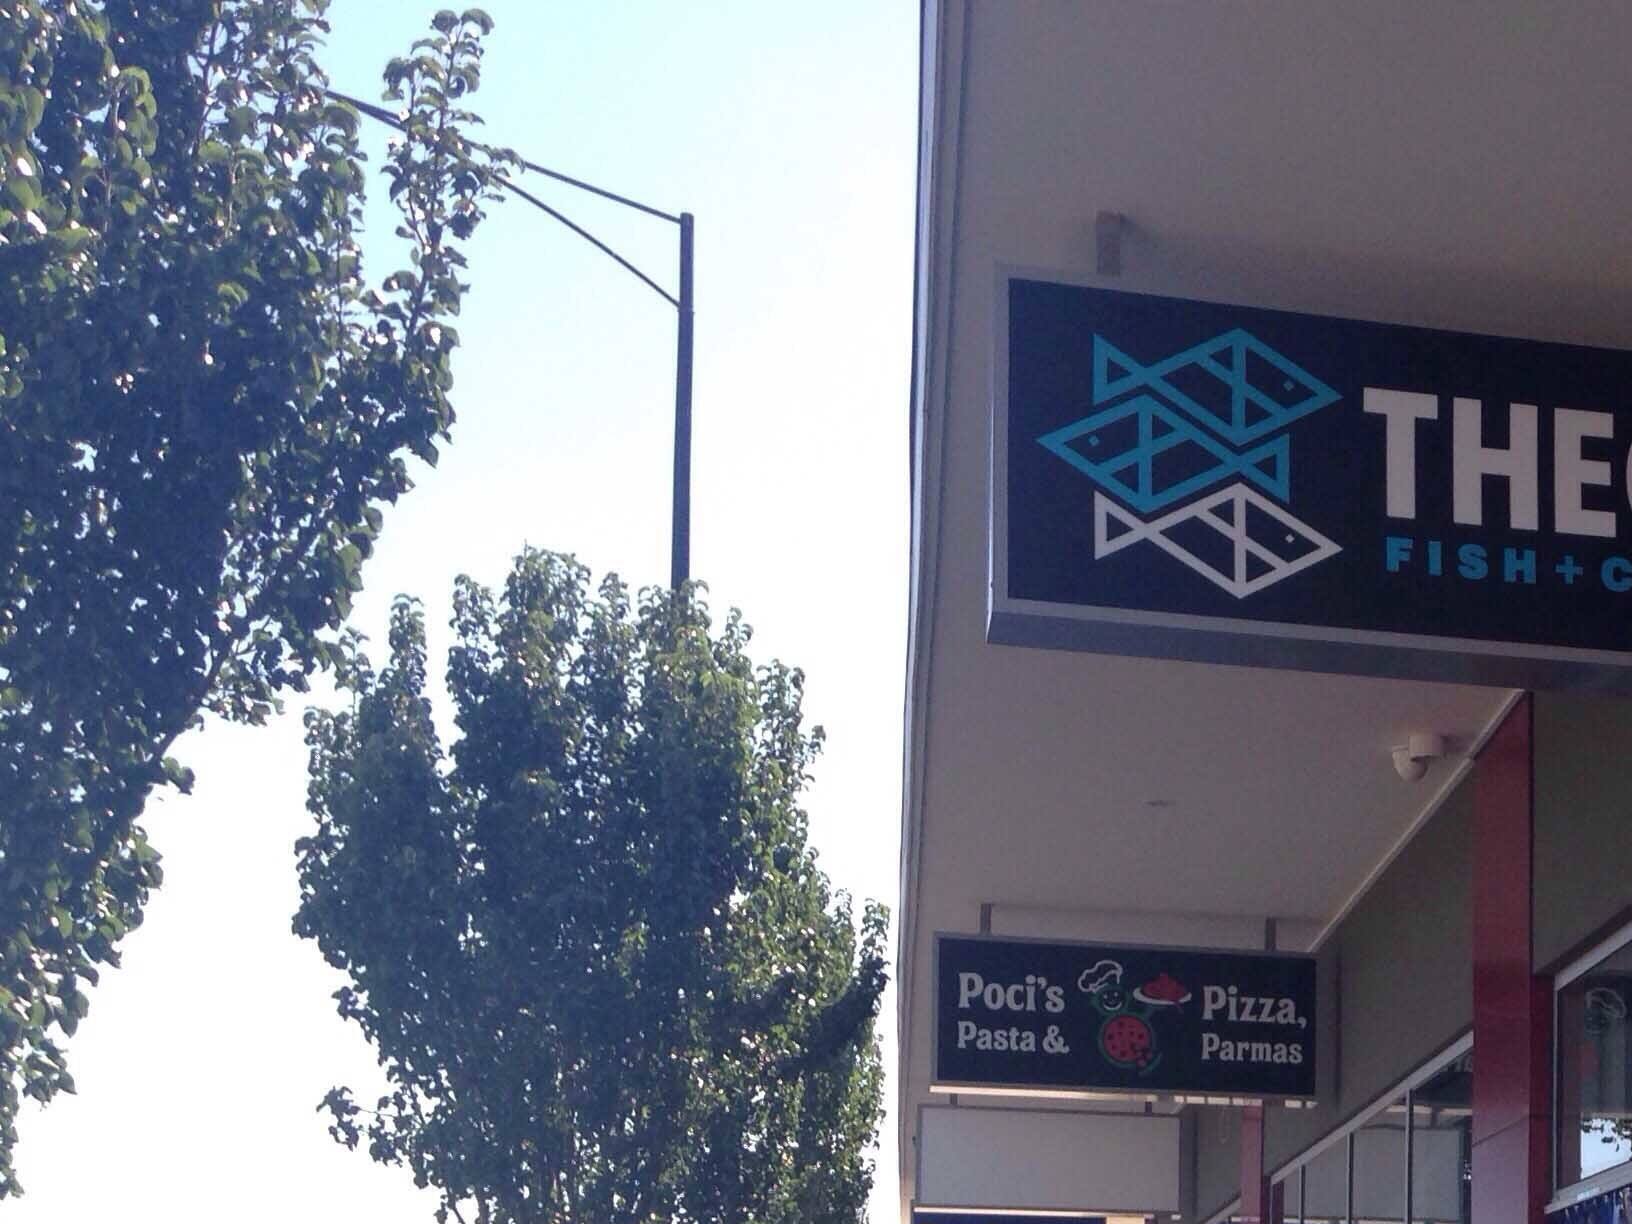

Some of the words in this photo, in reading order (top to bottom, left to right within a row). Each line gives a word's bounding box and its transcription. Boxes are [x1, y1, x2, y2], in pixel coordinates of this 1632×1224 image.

[958, 972, 1065, 1013] Poci's
[1202, 985, 1307, 1029] Pizza,
[958, 1021, 1036, 1052] Pasta
[1042, 1024, 1070, 1053] &
[1201, 1033, 1303, 1064] Parmas
